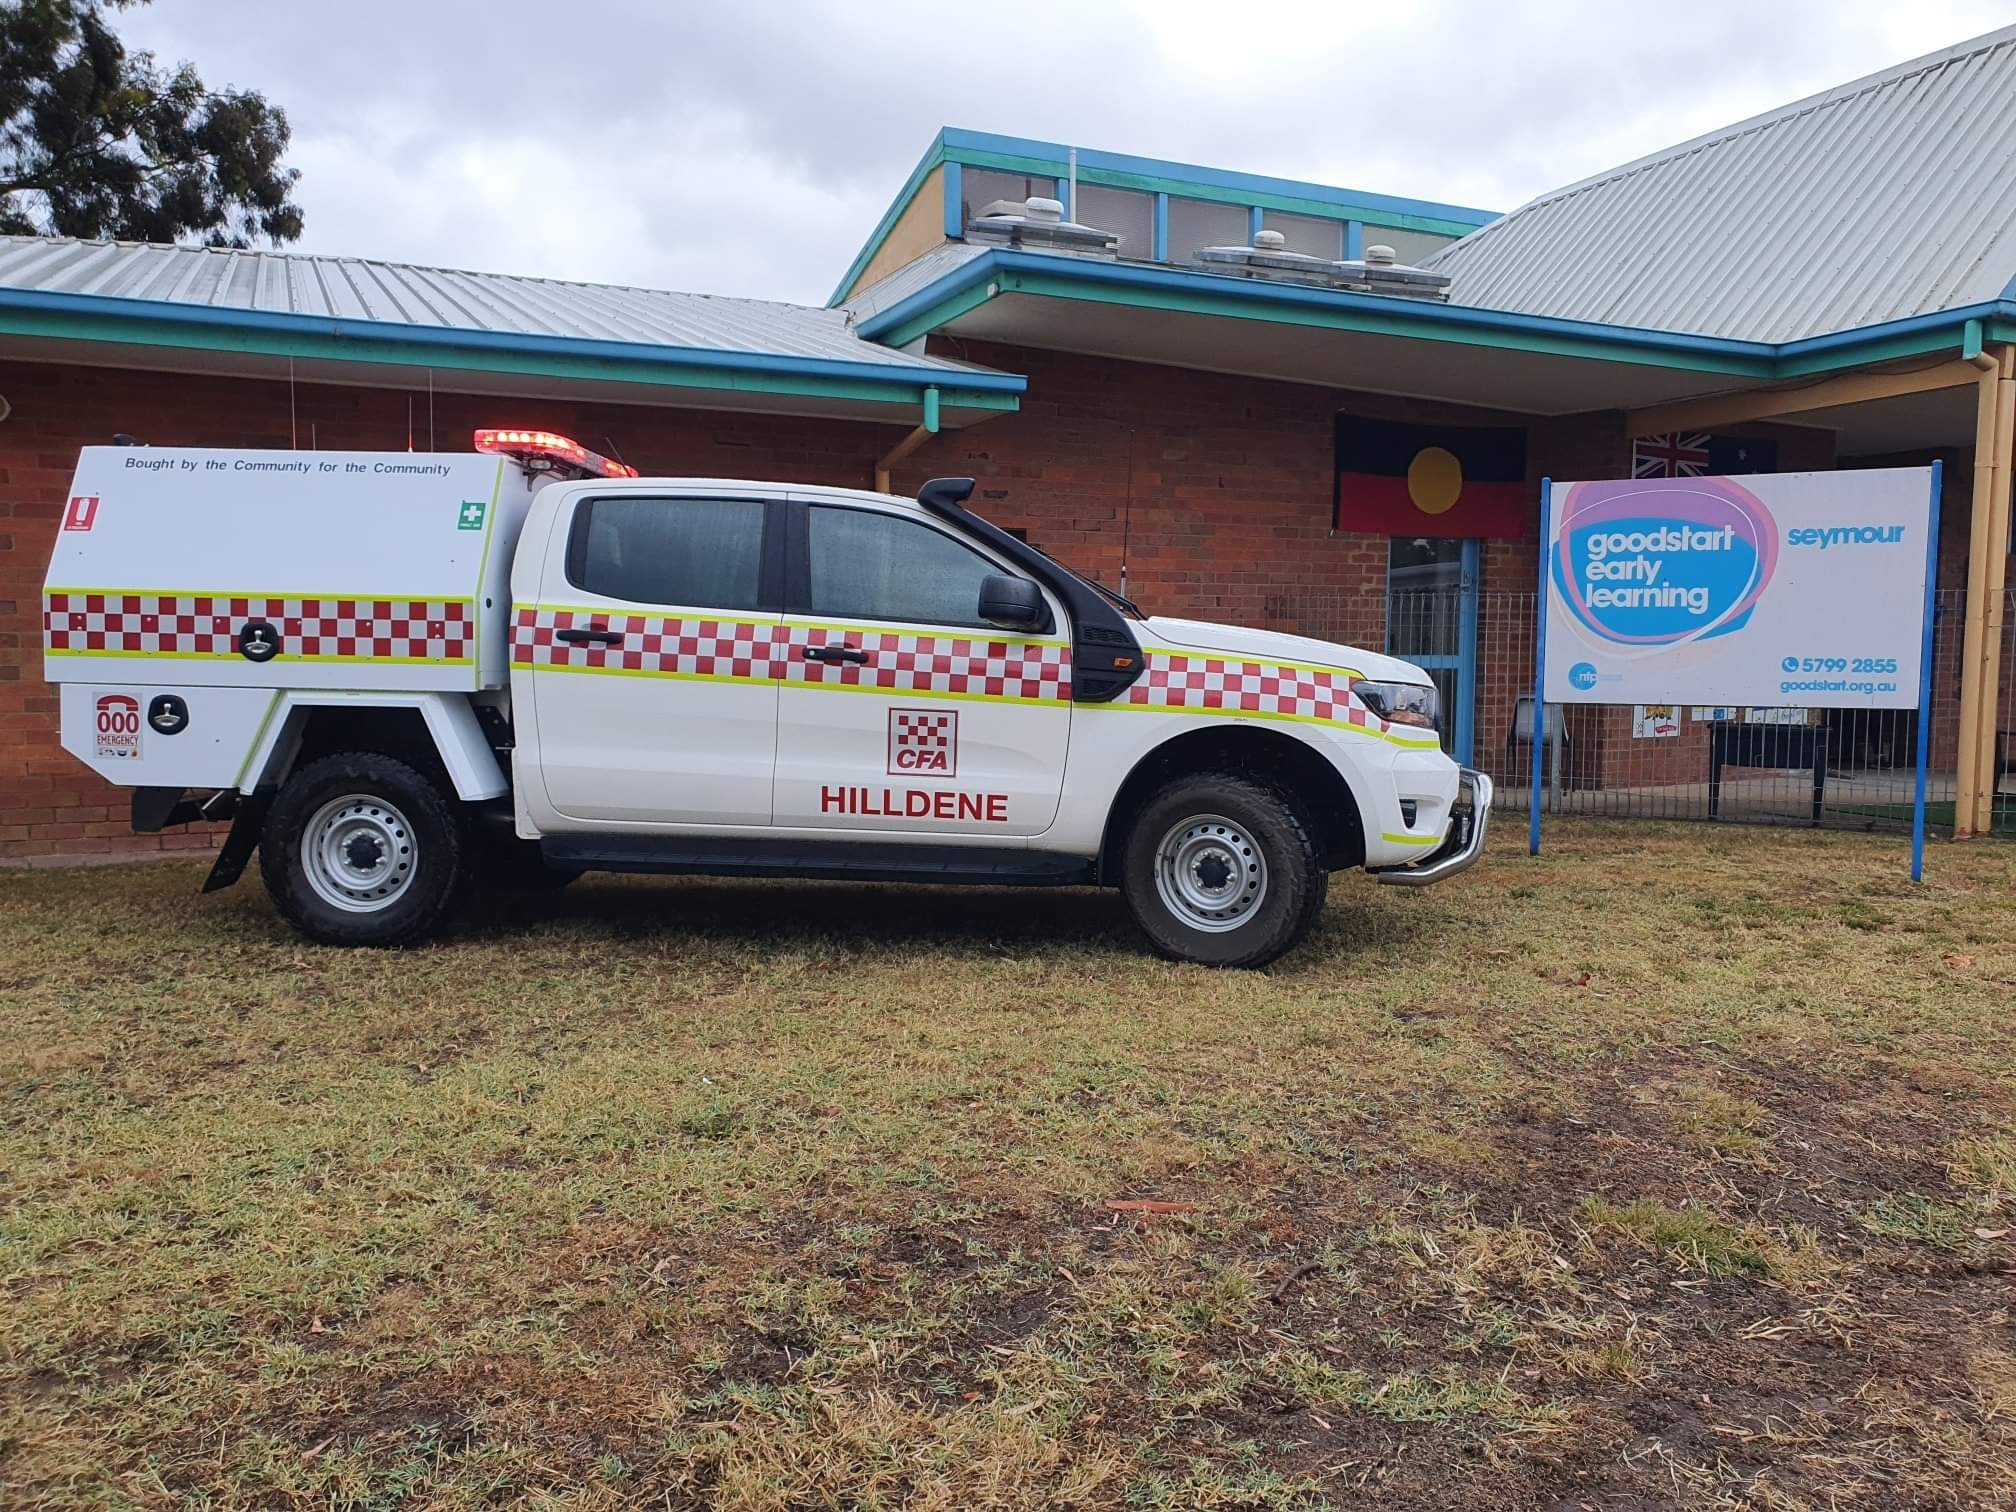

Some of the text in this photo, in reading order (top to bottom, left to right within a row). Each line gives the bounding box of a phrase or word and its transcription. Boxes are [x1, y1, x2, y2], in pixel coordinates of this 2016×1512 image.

[125, 457, 451, 476] Bought by the Community for the Community
[1587, 525, 1735, 560] goodstart
[1788, 526, 1905, 549] seymour
[1586, 555, 1662, 585] early
[1586, 582, 1708, 614] learning
[1803, 658, 1897, 673] 5799 2855
[1781, 680, 1897, 694] goodstart.org.au
[97, 711, 139, 734] 000
[97, 735, 139, 745] EMERGENCY
[896, 749, 947, 770] CFA
[821, 785, 1009, 822] HILLDENE
